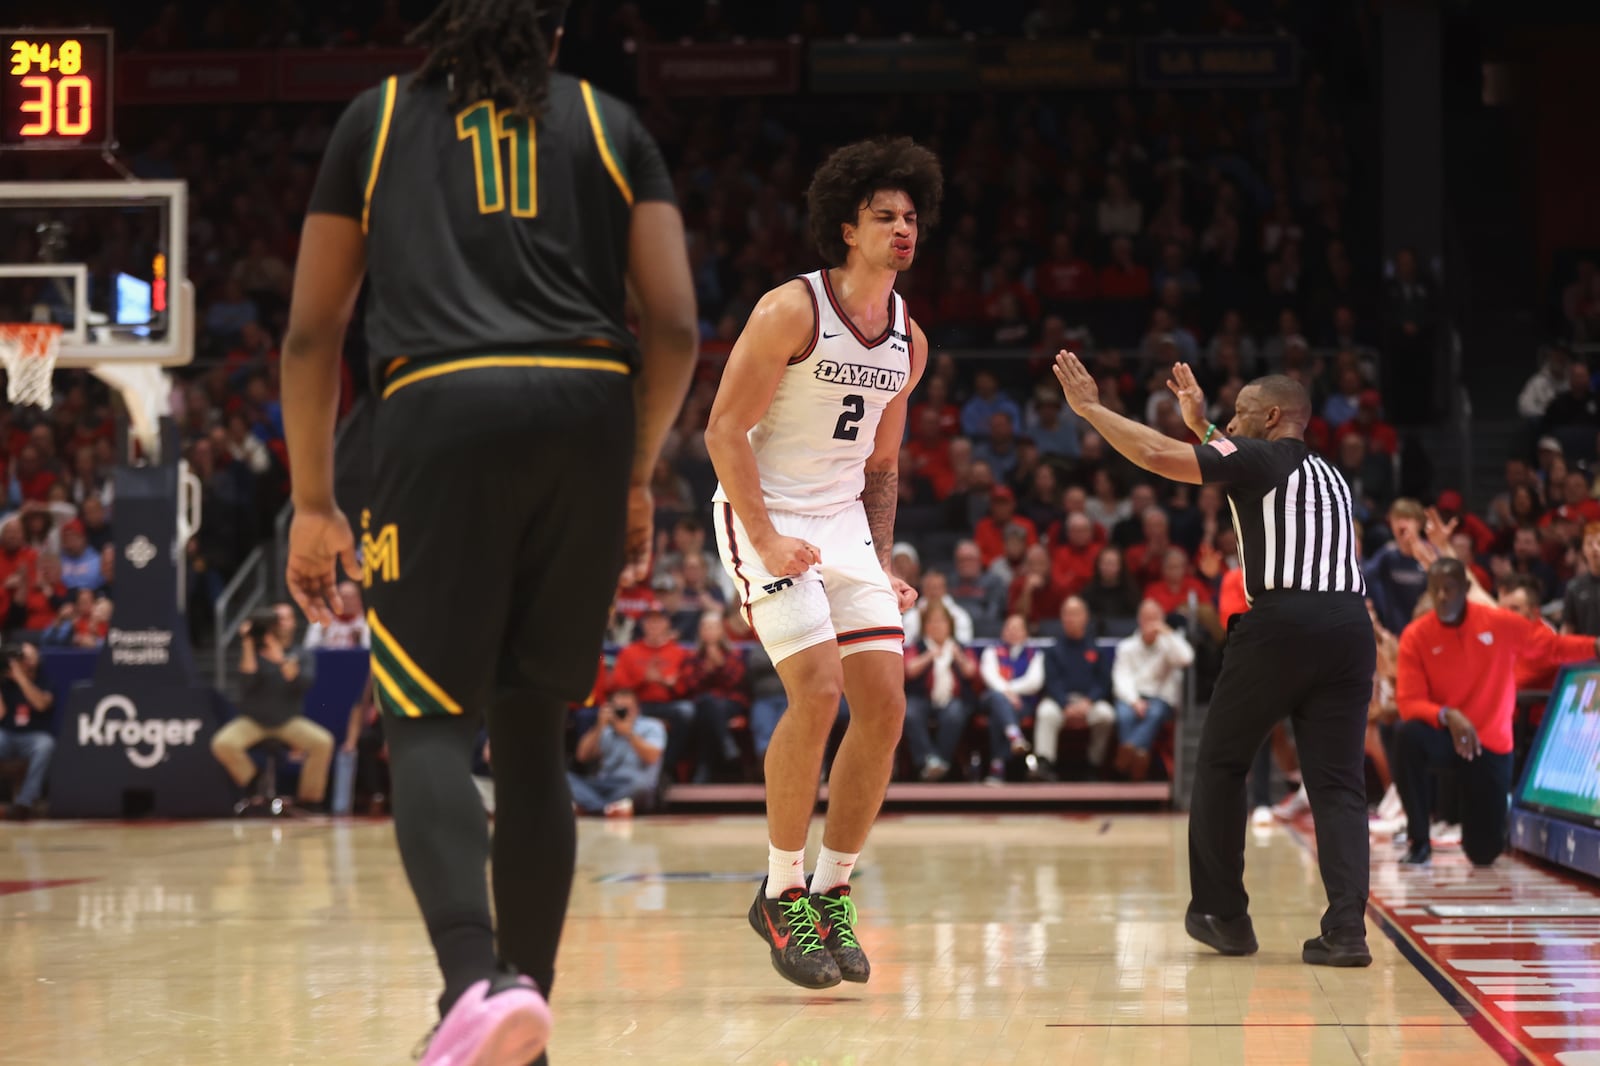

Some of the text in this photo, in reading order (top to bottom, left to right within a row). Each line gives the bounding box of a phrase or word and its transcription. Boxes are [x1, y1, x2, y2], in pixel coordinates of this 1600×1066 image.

[10, 40, 82, 75] 34.8
[19, 76, 92, 136] 30
[455, 99, 538, 219] 11
[813, 360, 906, 393] DAYTON
[832, 394, 865, 441] 2
[108, 628, 172, 648] Premier
[112, 648, 170, 665] Health
[78, 694, 203, 769] Kroger
